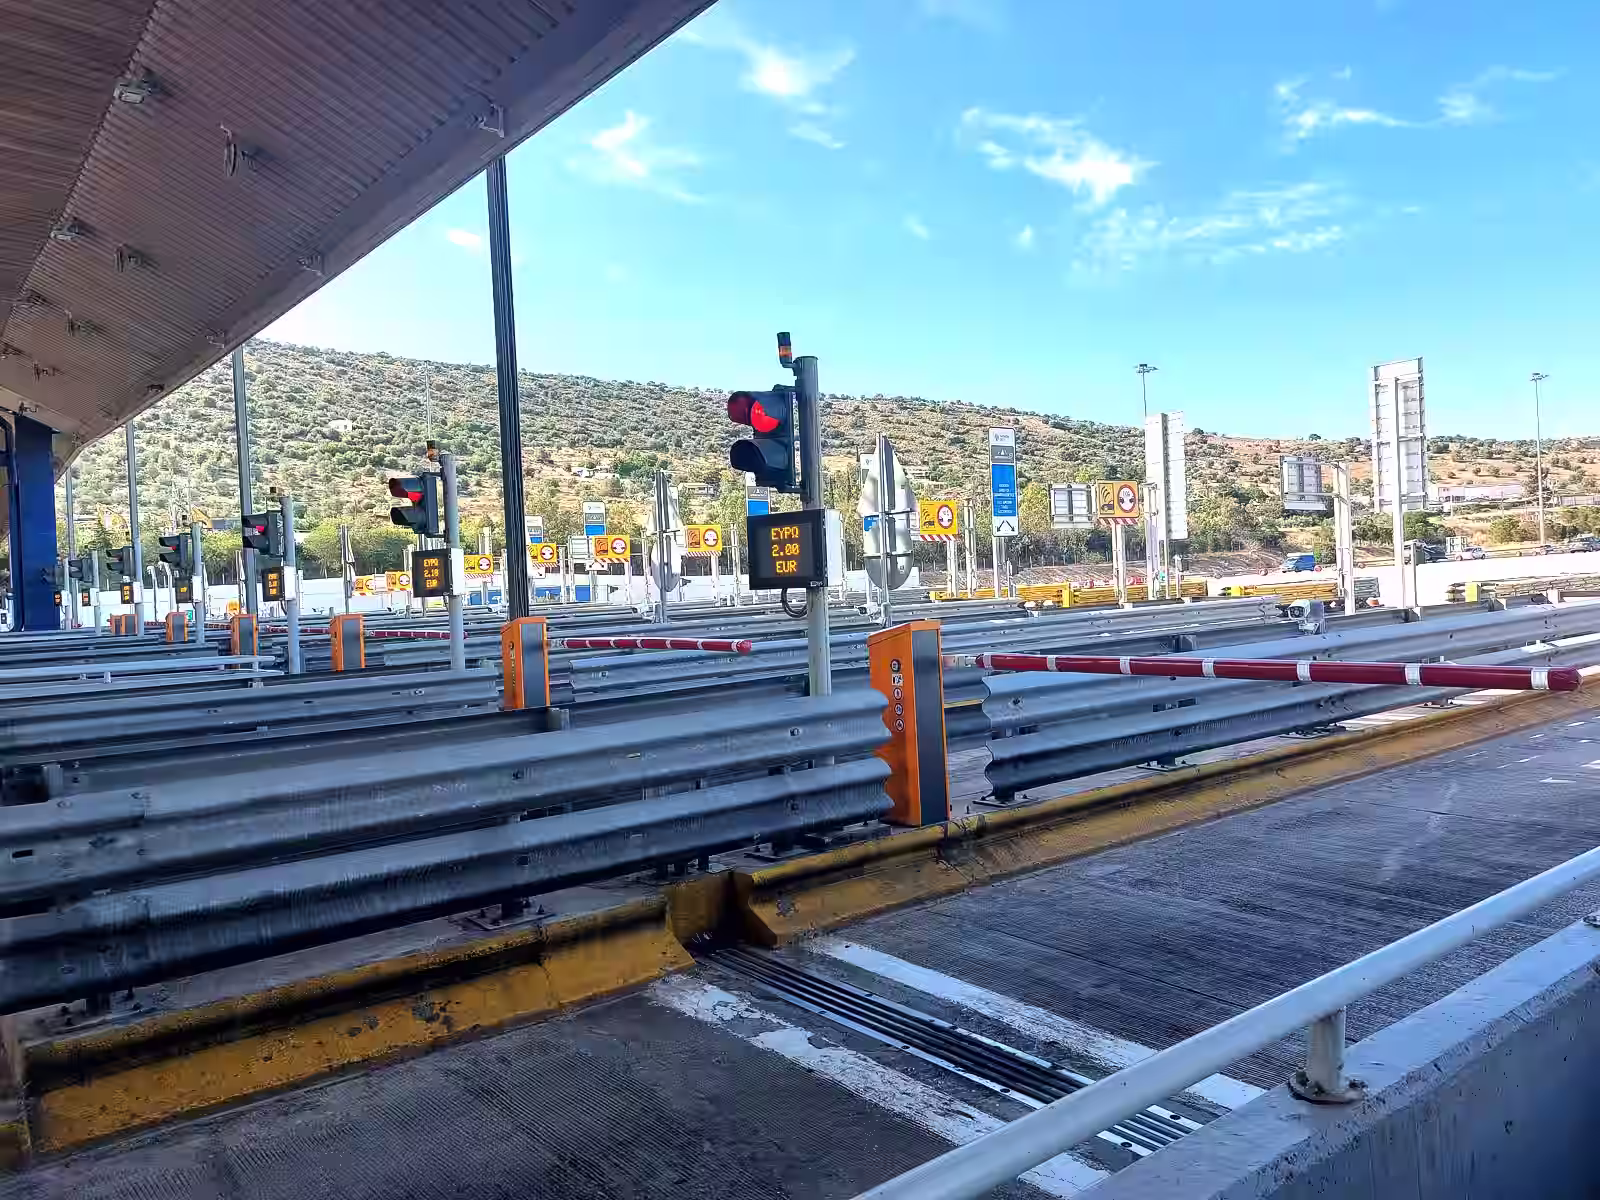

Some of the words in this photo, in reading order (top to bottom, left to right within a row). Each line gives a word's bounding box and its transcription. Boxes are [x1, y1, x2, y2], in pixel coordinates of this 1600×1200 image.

[771, 526, 799, 540] ΕΥΡΩ
[771, 543, 800, 557] 2.00
[775, 560, 797, 573] EUR
